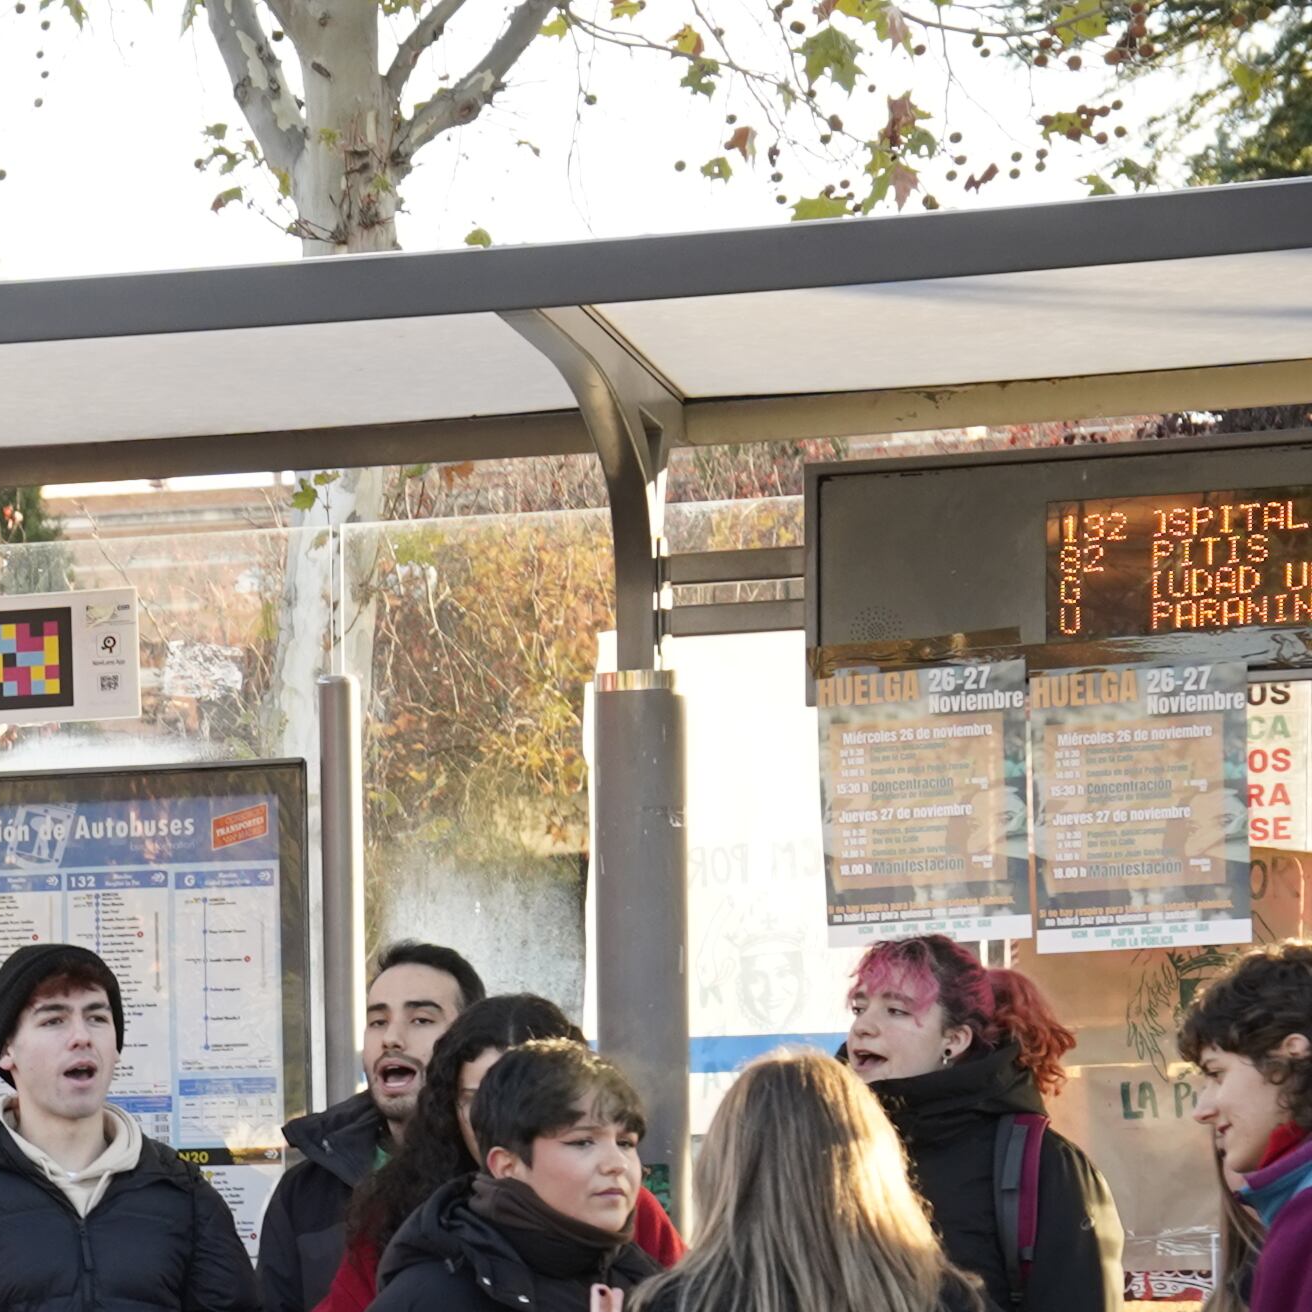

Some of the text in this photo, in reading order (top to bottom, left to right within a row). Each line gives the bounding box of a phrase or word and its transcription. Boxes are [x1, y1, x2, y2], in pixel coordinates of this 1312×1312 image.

[1063, 512, 1128, 543] 132
[1060, 534, 1269, 574] 82 PITIS
[1060, 575, 1081, 604] G
[1286, 561, 1312, 591] U
[1060, 606, 1081, 635] U
[818, 670, 921, 708] HUELGA
[928, 666, 990, 693] 26-27
[1031, 670, 1139, 709] HUELGA
[1147, 667, 1211, 694] 26-27
[928, 689, 1024, 714] Noviembre
[1147, 690, 1245, 715] Noviembre
[843, 723, 993, 745] Miércoles 26 de noviembre
[1057, 724, 1212, 746] Miércoles 26 de noviembre
[871, 777, 953, 793] Concentración
[1087, 778, 1172, 795] Concentración
[40, 817, 65, 840] de
[74, 812, 195, 840] Autobuses
[839, 803, 973, 824] Jueves 27 de noviembre
[1052, 805, 1191, 826] Jueves 27 de noviembre
[873, 857, 964, 875] Manifestación
[1088, 860, 1182, 878] Manifestación
[70, 875, 96, 888] 132
[184, 875, 195, 887] G
[1120, 1081, 1159, 1120] LA
